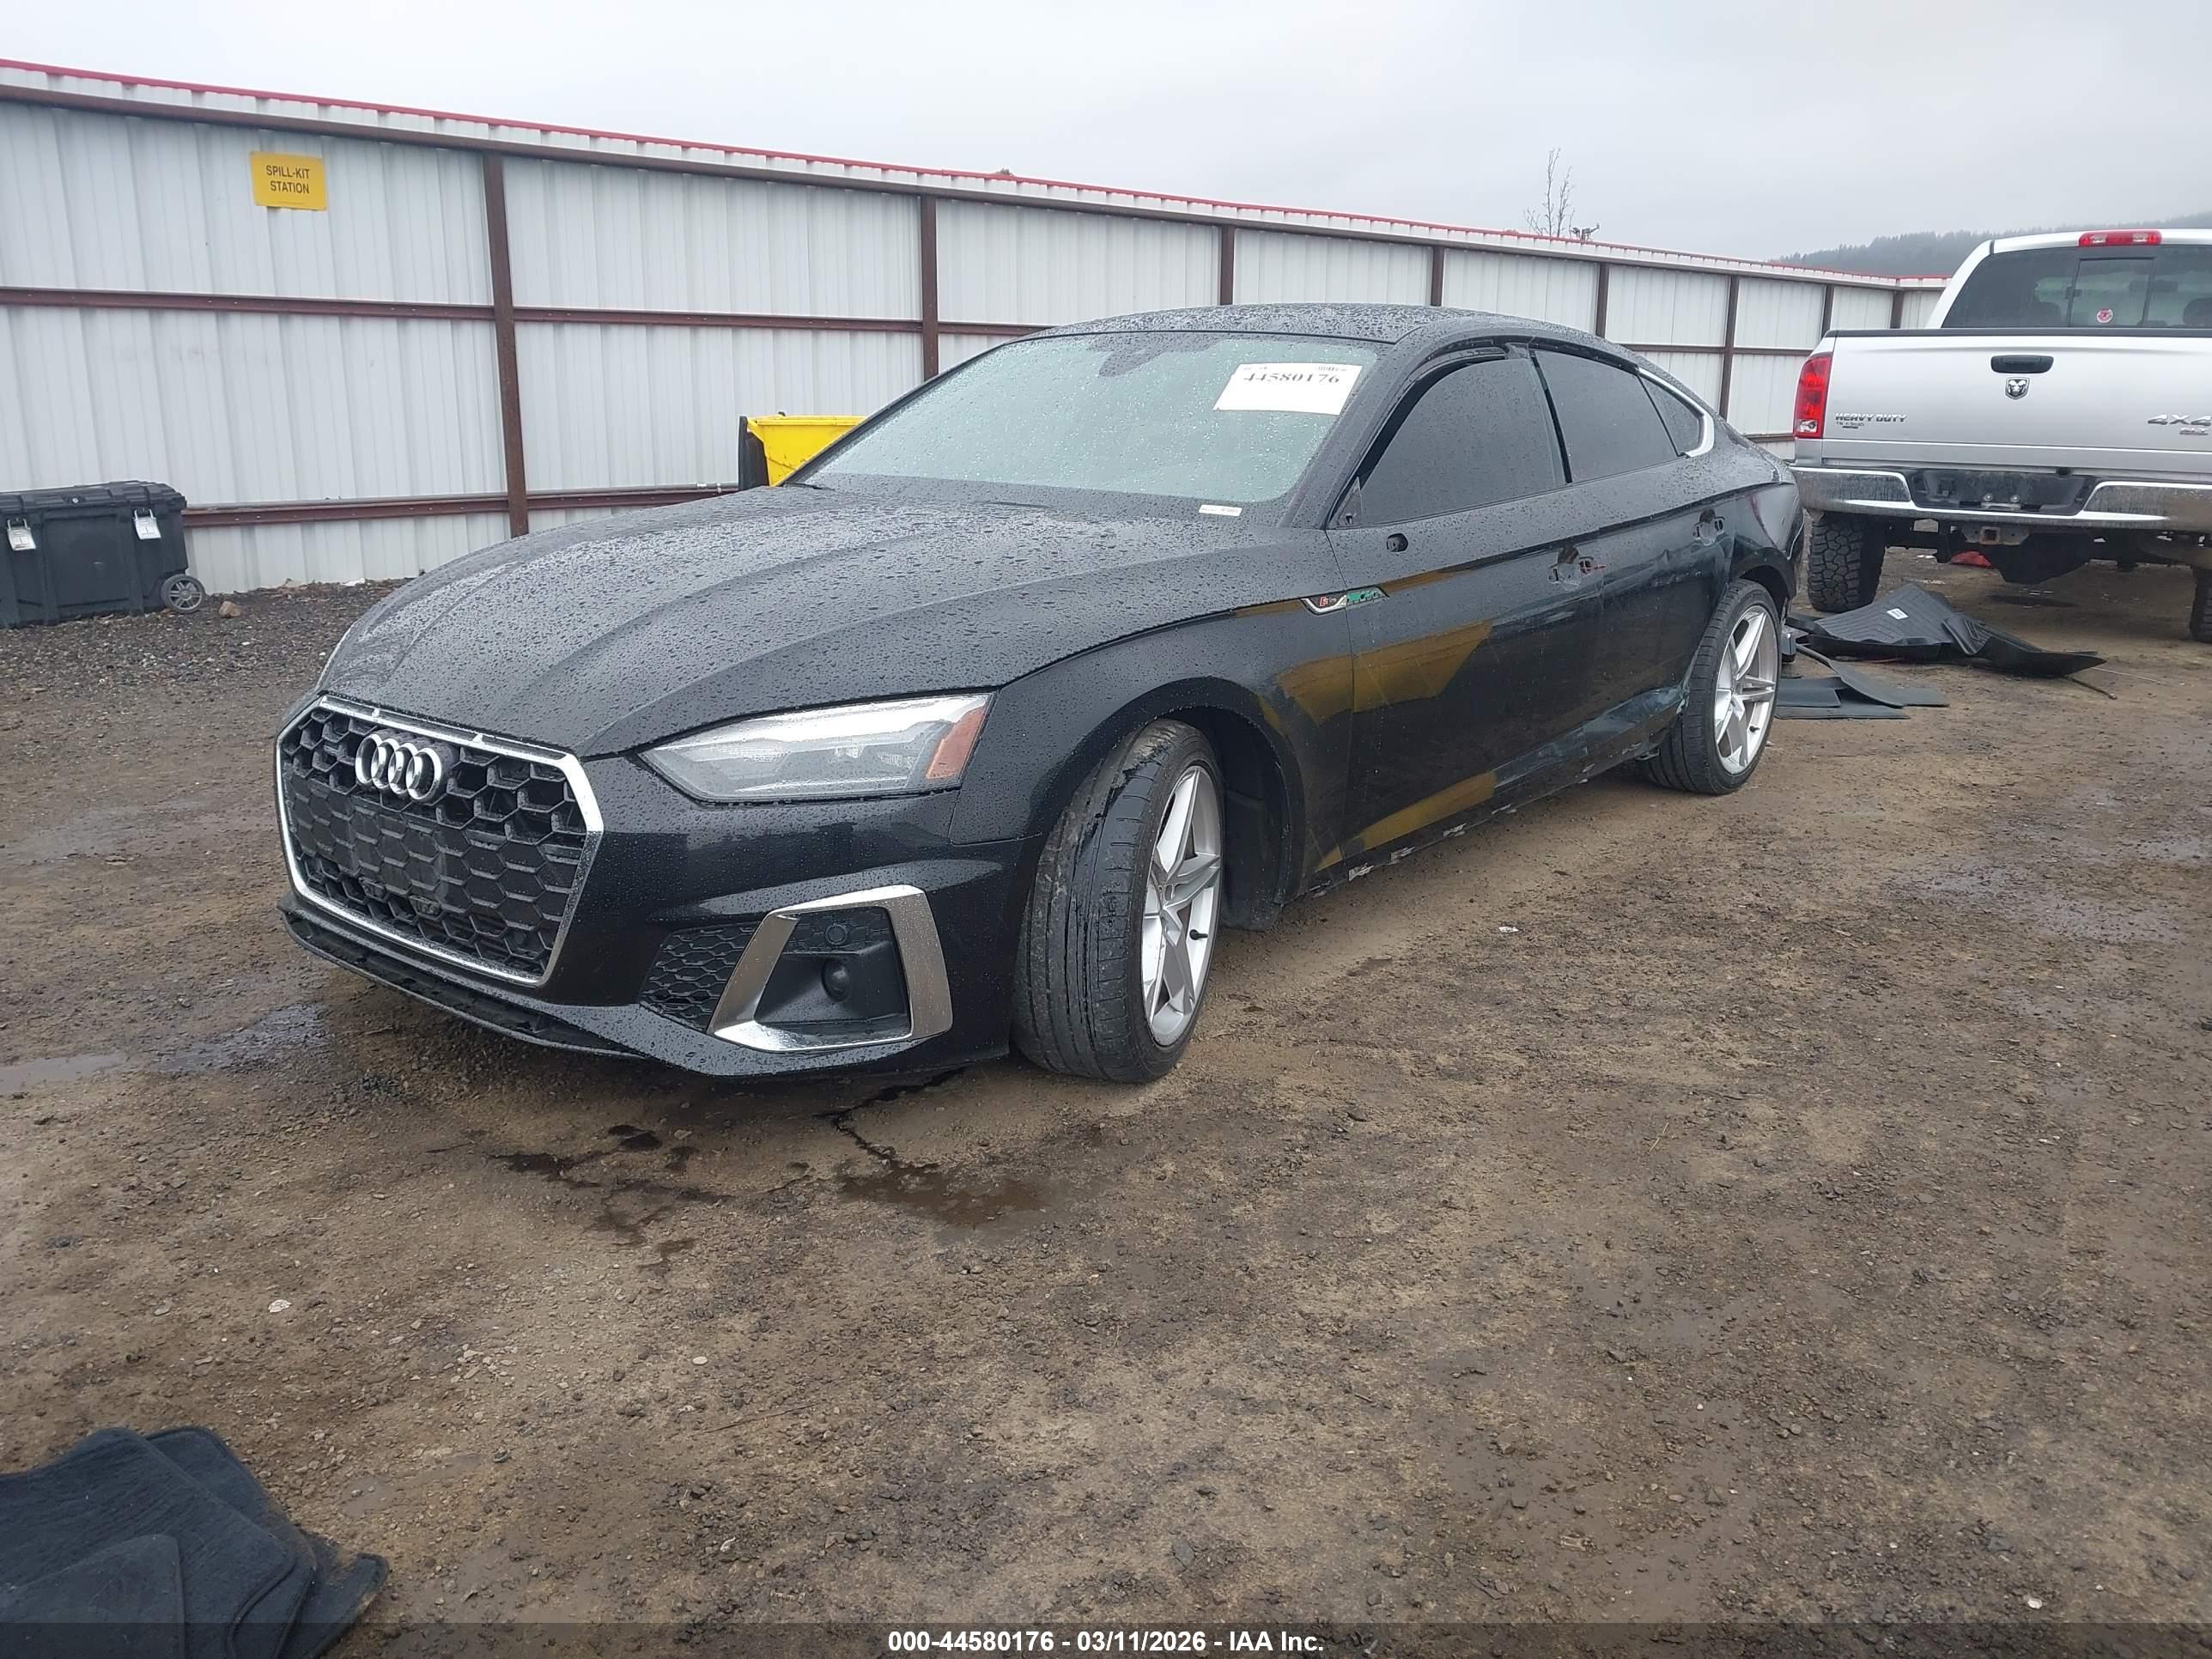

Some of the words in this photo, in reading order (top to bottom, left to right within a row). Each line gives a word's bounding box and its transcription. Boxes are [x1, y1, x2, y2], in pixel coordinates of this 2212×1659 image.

[265, 165, 310, 179] SPILL-KIT
[270, 179, 310, 194] STATION
[1243, 372, 1340, 384] 44580176
[1835, 412, 1874, 422] HEAVY
[1875, 414, 1907, 422] DUTY
